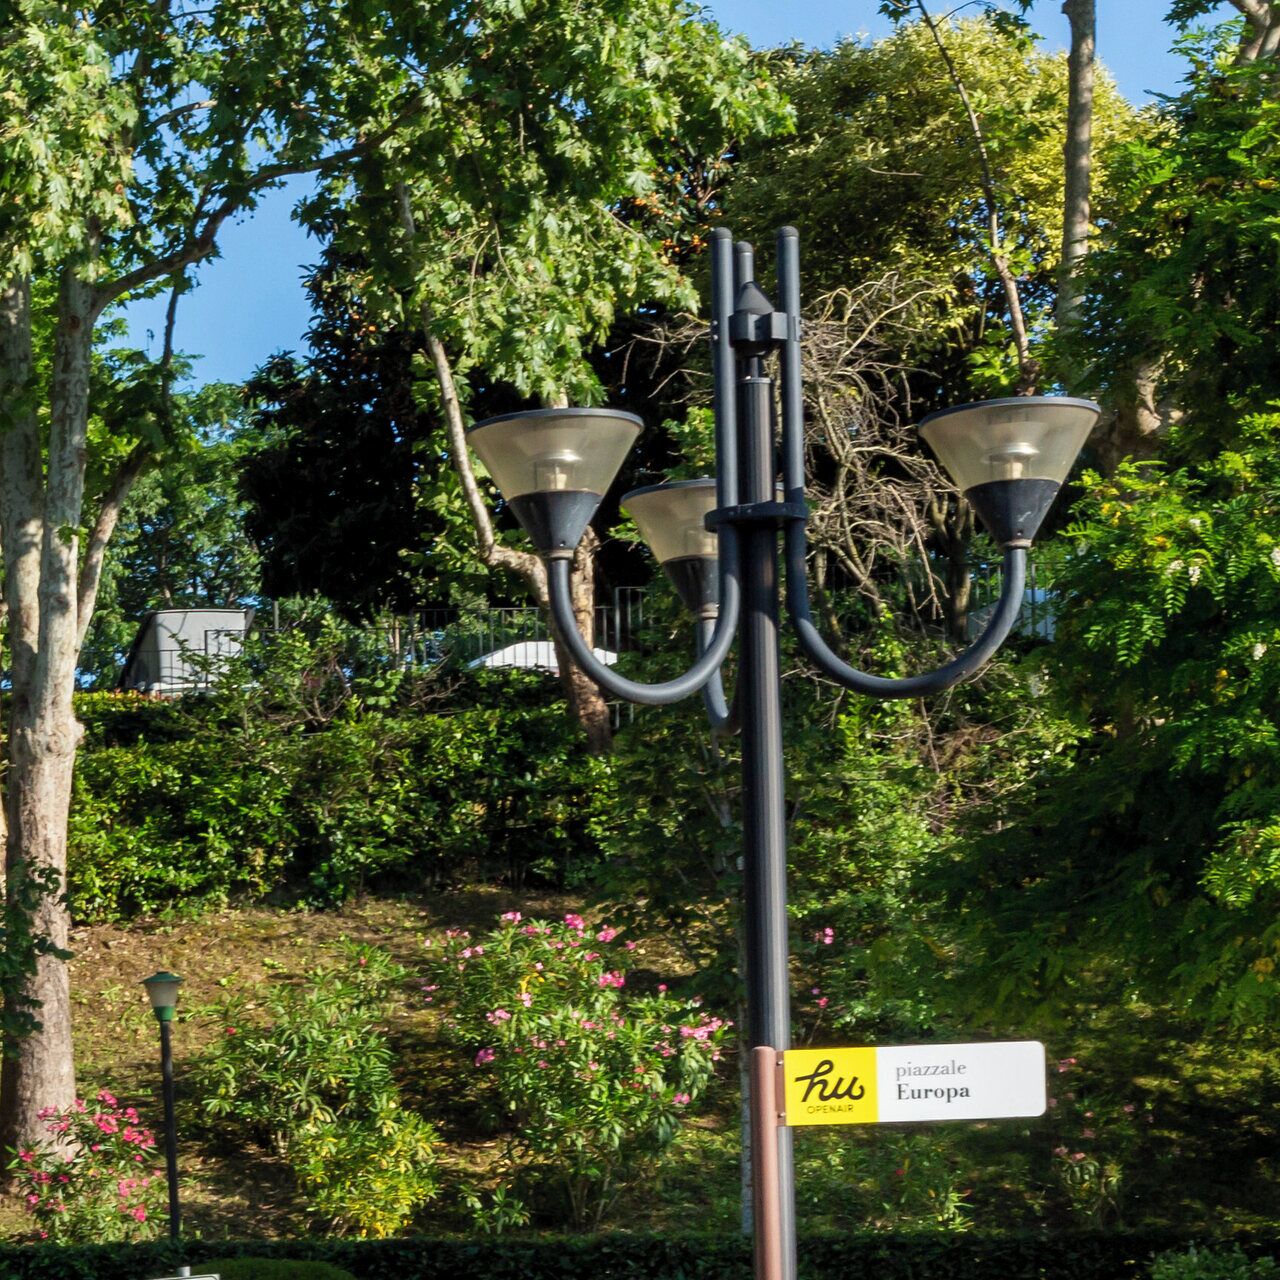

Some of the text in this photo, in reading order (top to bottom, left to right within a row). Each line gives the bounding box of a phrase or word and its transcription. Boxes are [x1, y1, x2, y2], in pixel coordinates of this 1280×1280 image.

[896, 1060, 967, 1081] piazzale
[896, 1083, 971, 1104] Europa
[807, 1104, 854, 1115] OPENAIR
